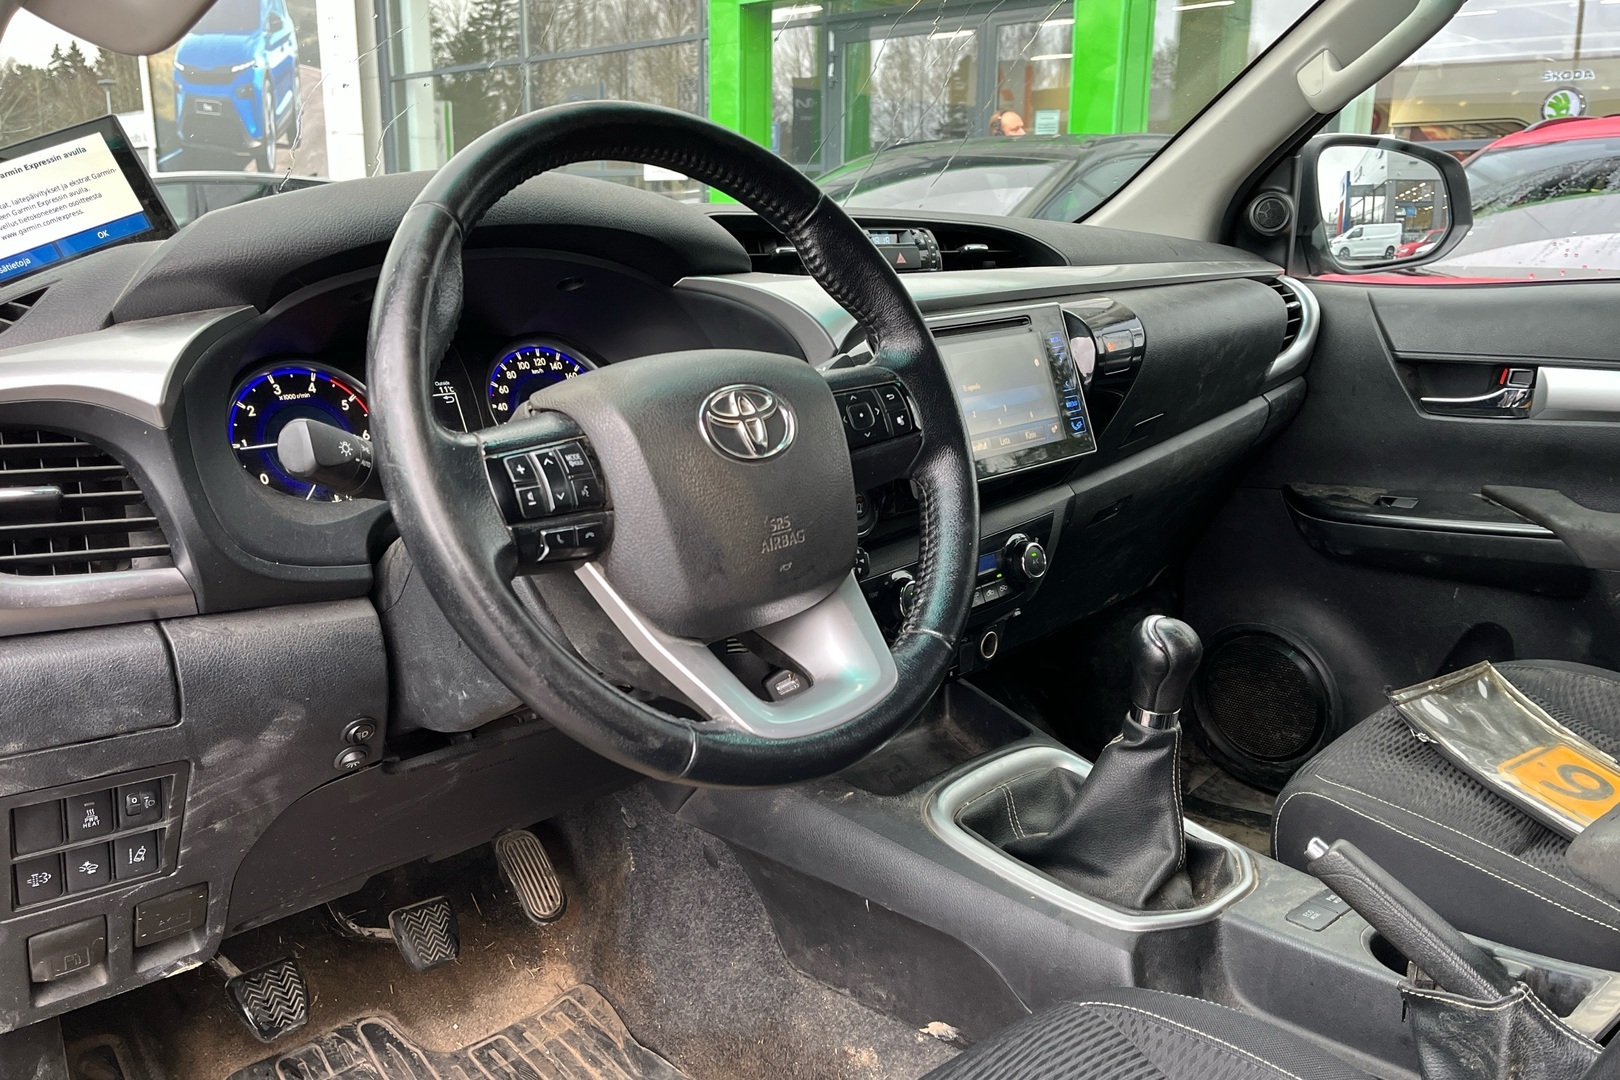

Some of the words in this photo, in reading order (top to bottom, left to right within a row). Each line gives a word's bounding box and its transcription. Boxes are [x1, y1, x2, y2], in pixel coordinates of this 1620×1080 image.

[23, 155, 62, 171] Expressin
[63, 147, 87, 158] avulla
[60, 183, 69, 191] ja
[69, 176, 91, 187] ekstrat
[11, 204, 37, 216] Garmin
[36, 193, 68, 208] Expressin
[18, 204, 68, 224] tietokoneeseen
[68, 192, 103, 208] osoitteesta
[97, 229, 110, 239] OK
[517, 361, 530, 370] 100
[533, 357, 546, 366] 120
[549, 361, 563, 371] 140
[506, 370, 517, 379] 80
[272, 383, 282, 395] 3
[308, 382, 317, 394] 4
[498, 385, 509, 394] 60
[246, 405, 256, 417] 2
[341, 400, 350, 411] 5
[497, 402, 508, 411] 40
[362, 430, 371, 441] 6
[770, 515, 791, 532] SRS
[761, 529, 806, 554] AIRBAG
[82, 820, 100, 829] HEAT
[84, 815, 99, 823] PWR
